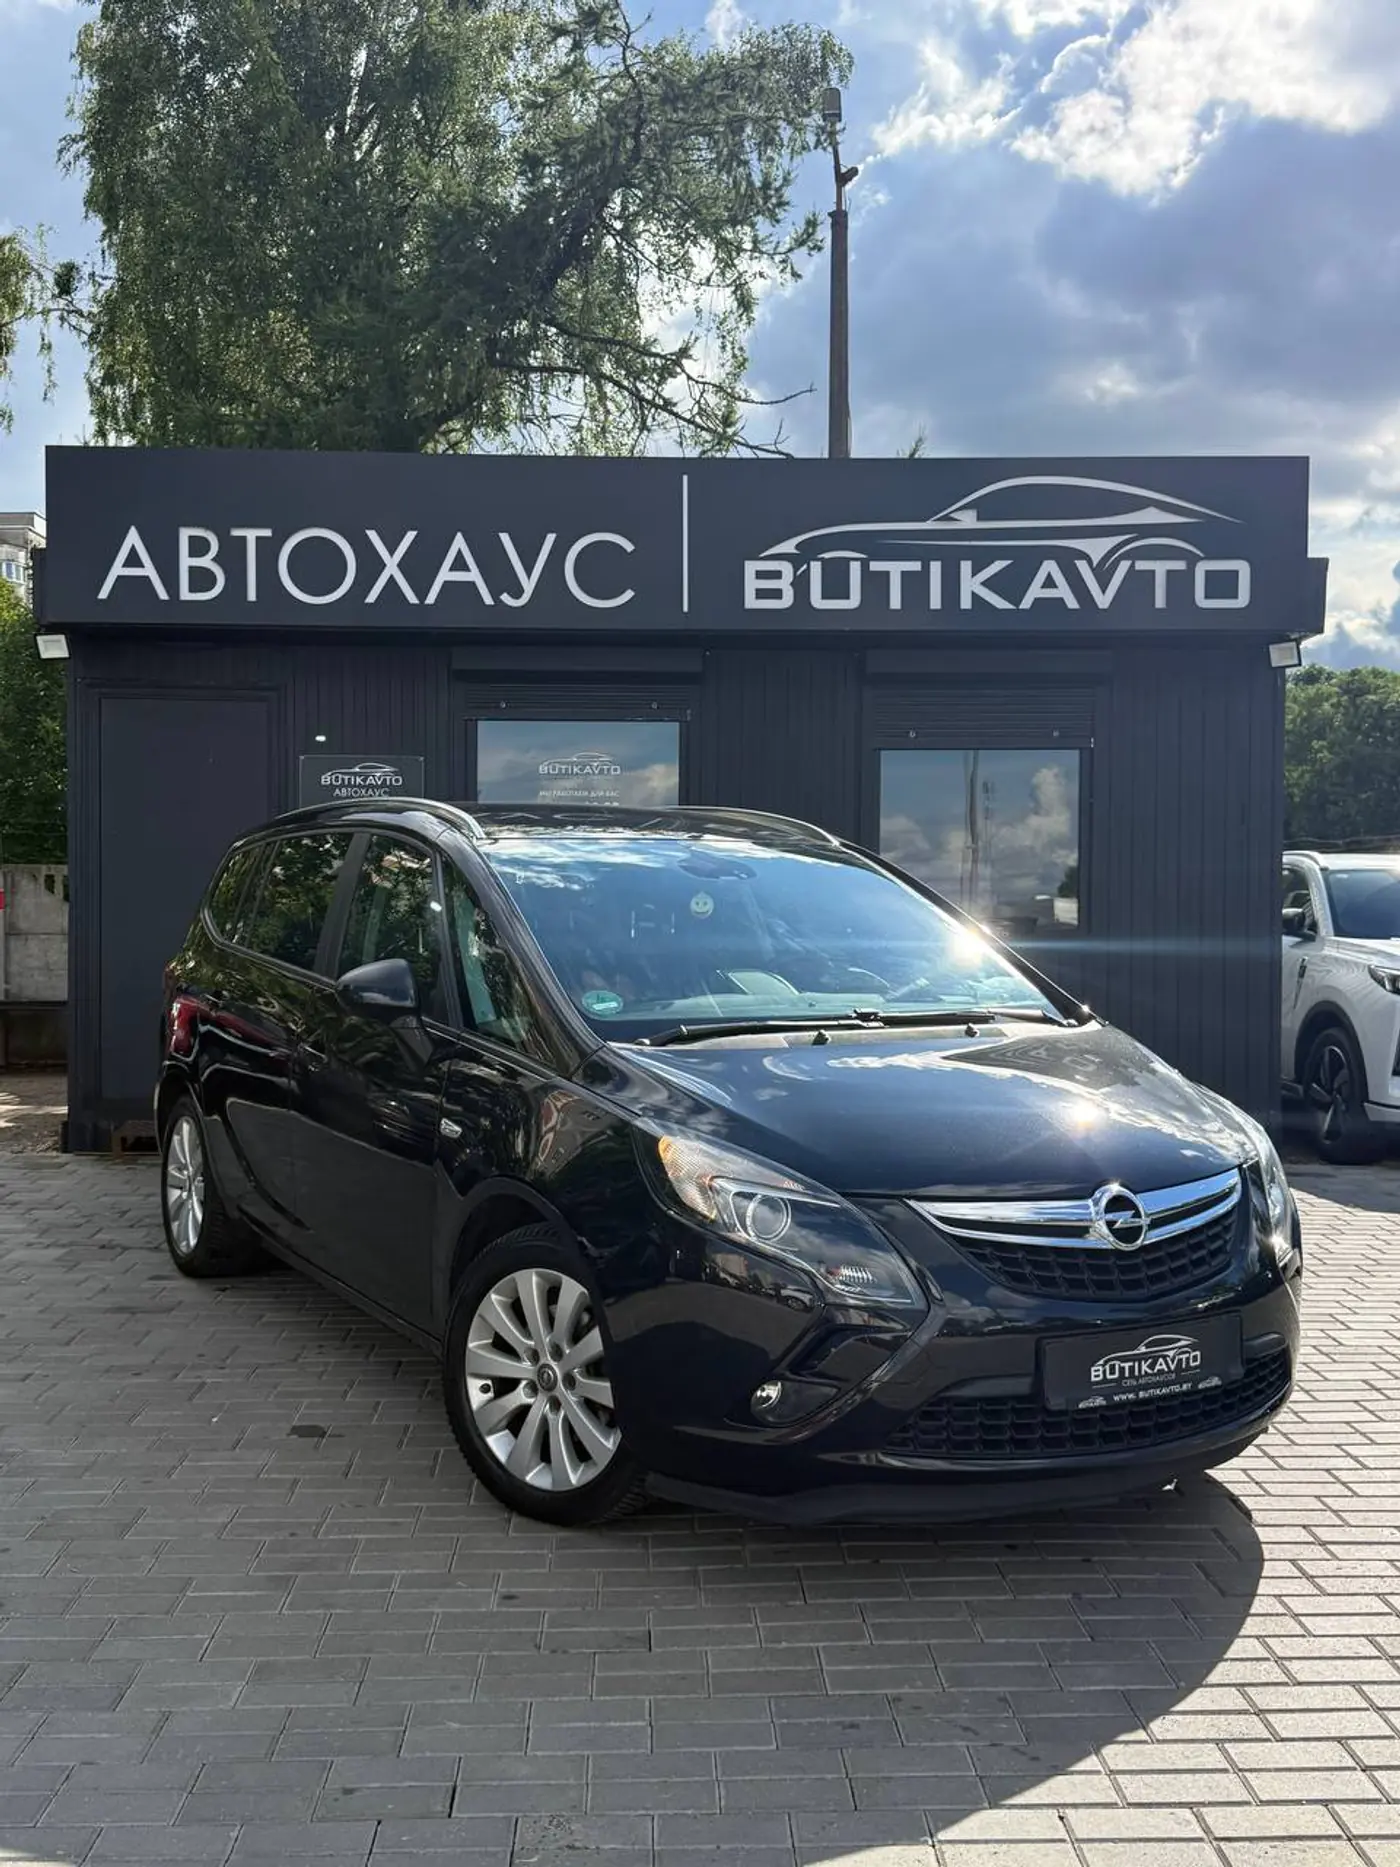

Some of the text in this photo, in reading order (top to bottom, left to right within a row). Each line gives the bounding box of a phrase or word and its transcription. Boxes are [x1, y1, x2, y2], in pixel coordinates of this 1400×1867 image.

[97, 525, 635, 608] АВТОХАУС
[743, 558, 1250, 611] BUTIKAVTO
[538, 764, 621, 775] BUTIKAVTO
[320, 775, 403, 786] BUTIKAVTO
[333, 788, 391, 797] АВТОХАУС
[1090, 1350, 1201, 1382] BUTIKAVTO
